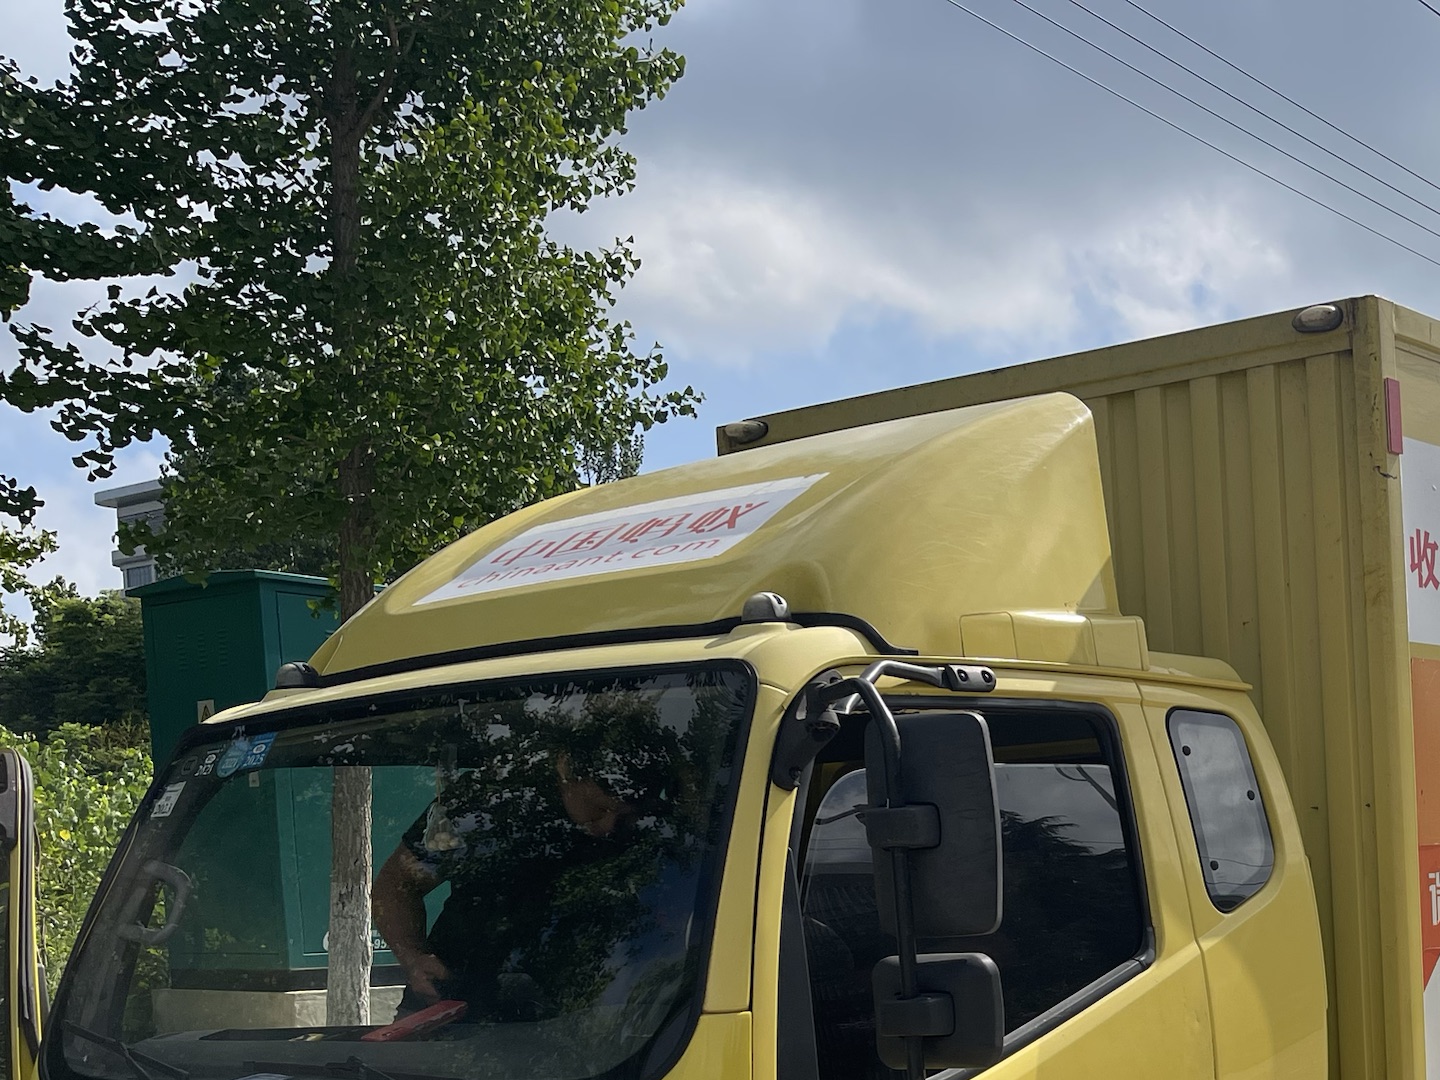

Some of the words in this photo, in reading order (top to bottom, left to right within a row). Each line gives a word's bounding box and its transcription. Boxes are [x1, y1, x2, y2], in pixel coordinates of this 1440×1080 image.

[457, 537, 720, 588] chinaant.com
[490, 501, 769, 566] 中国蚂蚁
